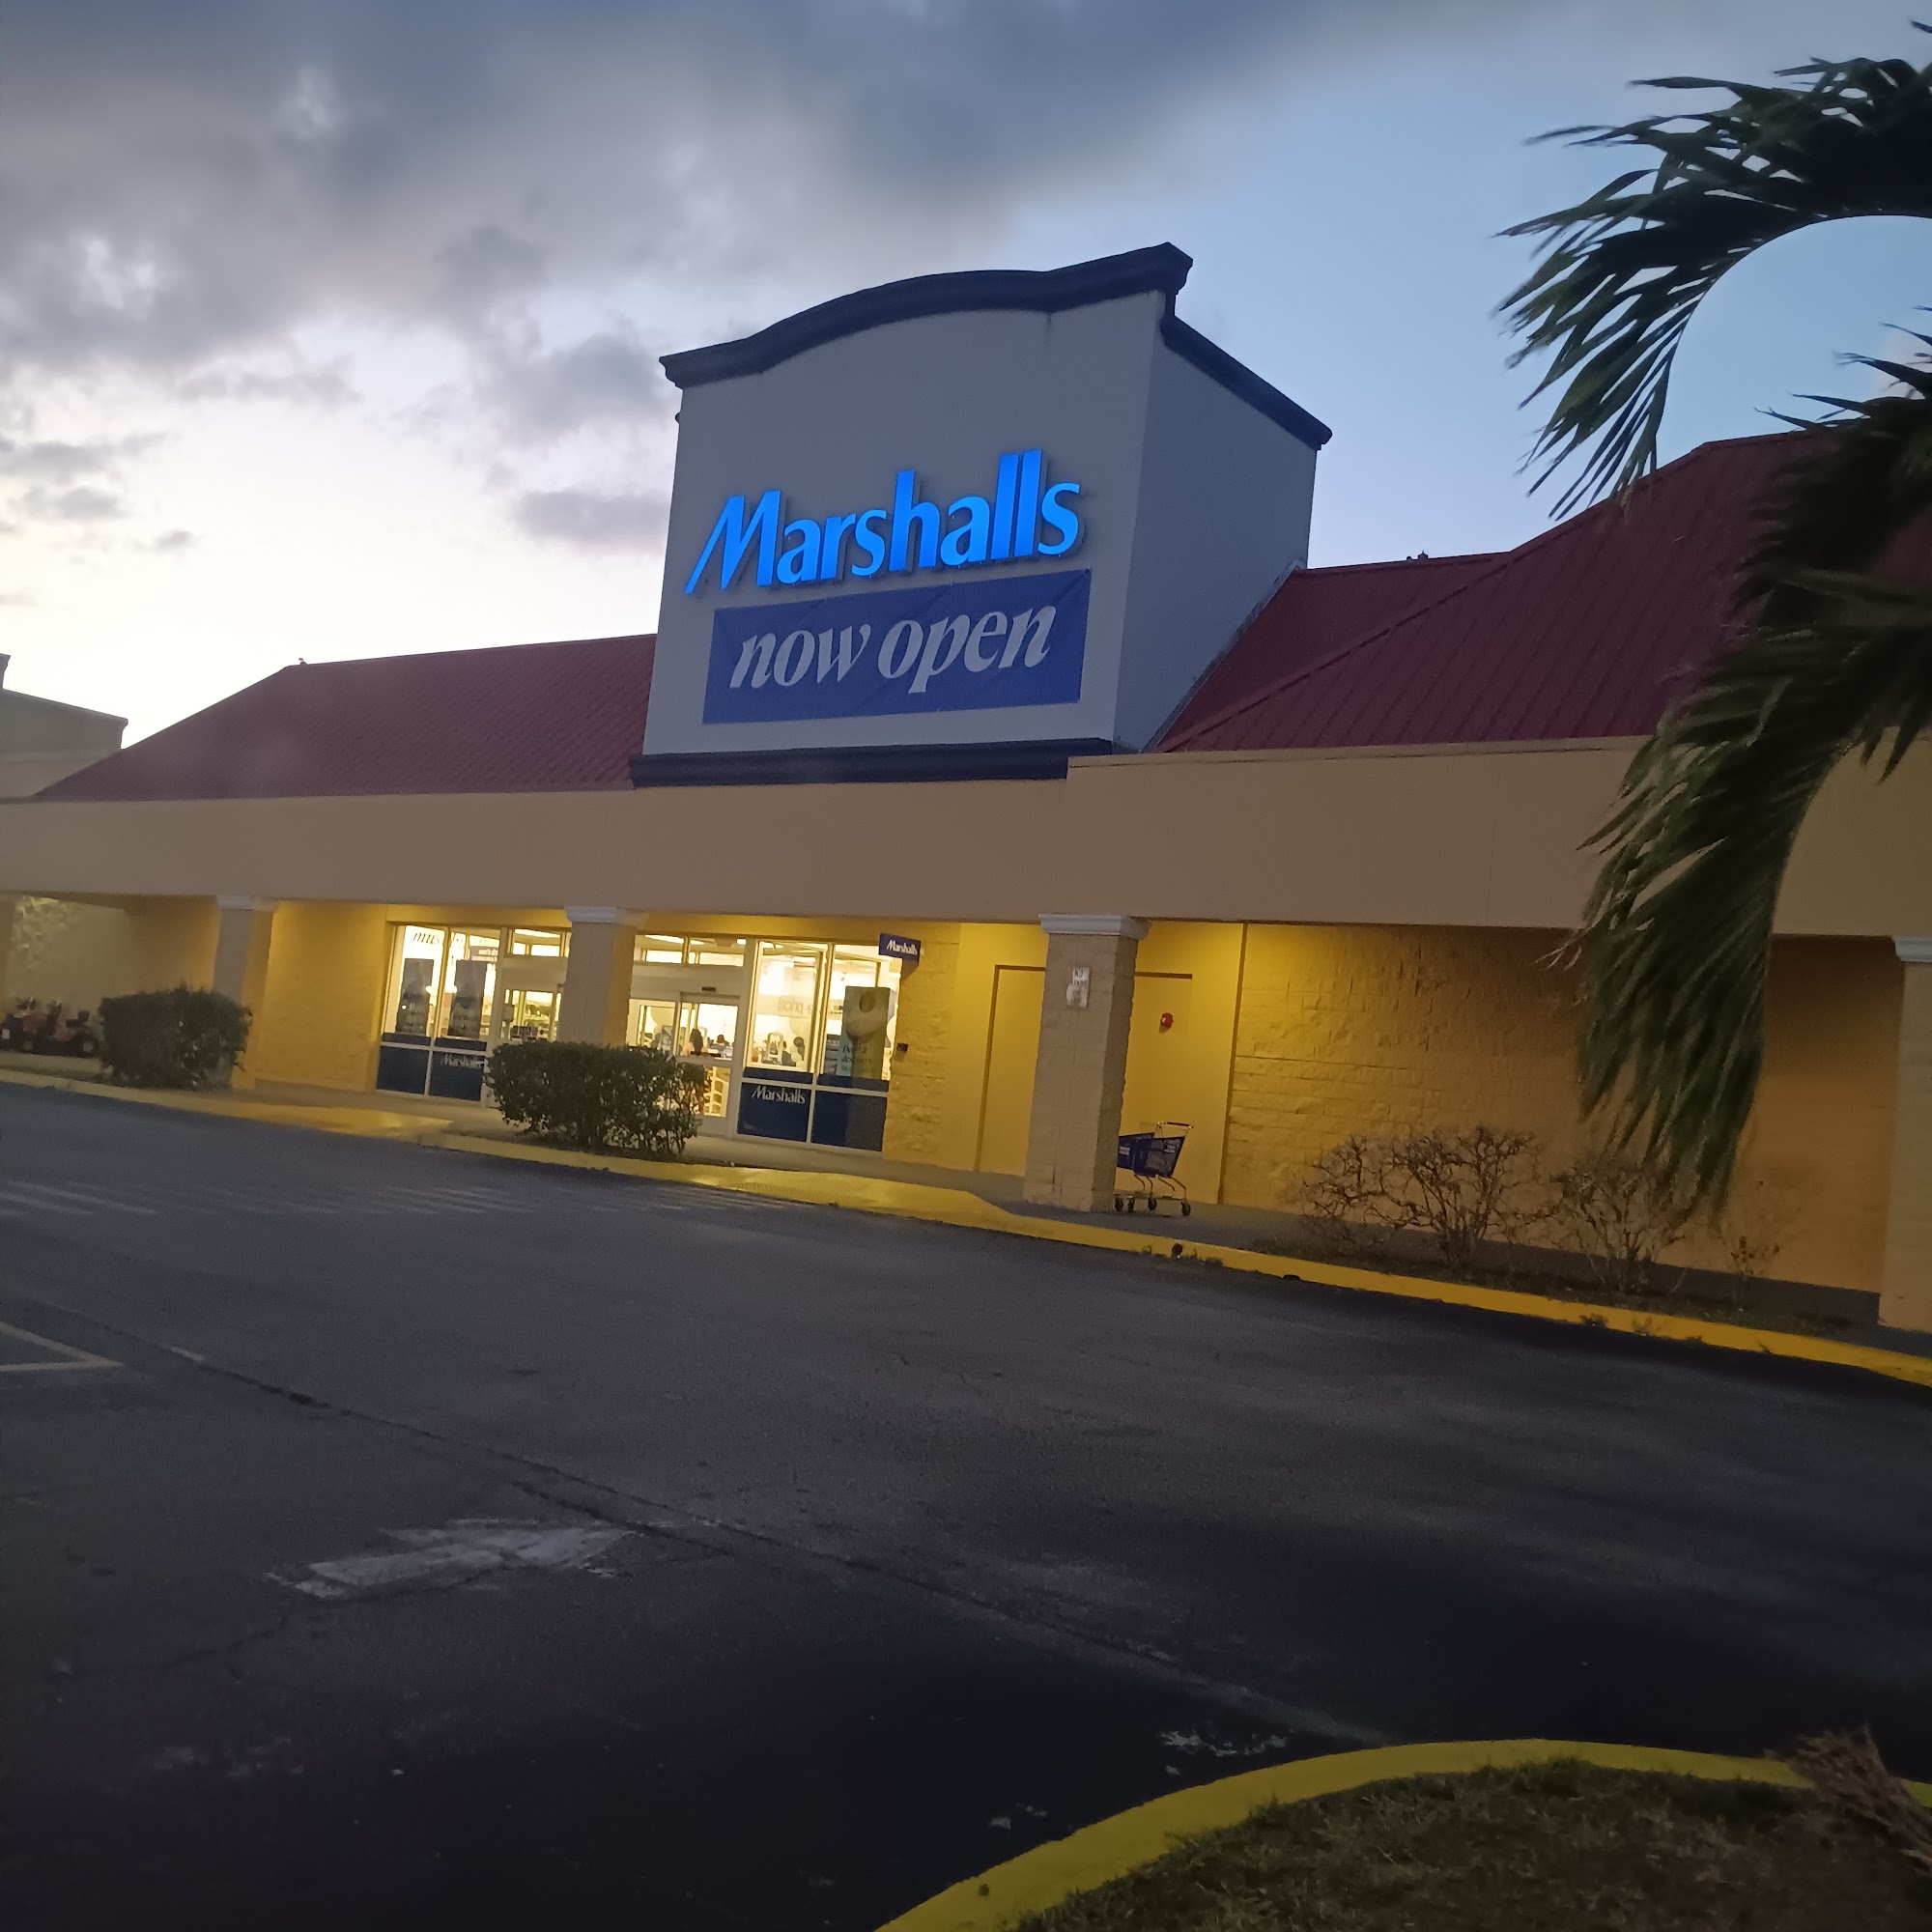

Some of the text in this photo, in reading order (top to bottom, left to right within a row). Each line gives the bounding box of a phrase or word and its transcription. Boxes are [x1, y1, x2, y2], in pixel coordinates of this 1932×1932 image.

[684, 449, 1080, 593] Marshalls
[729, 605, 1057, 694] now open
[886, 939, 919, 955] Marshalls
[751, 1084, 807, 1104] Marshalls
